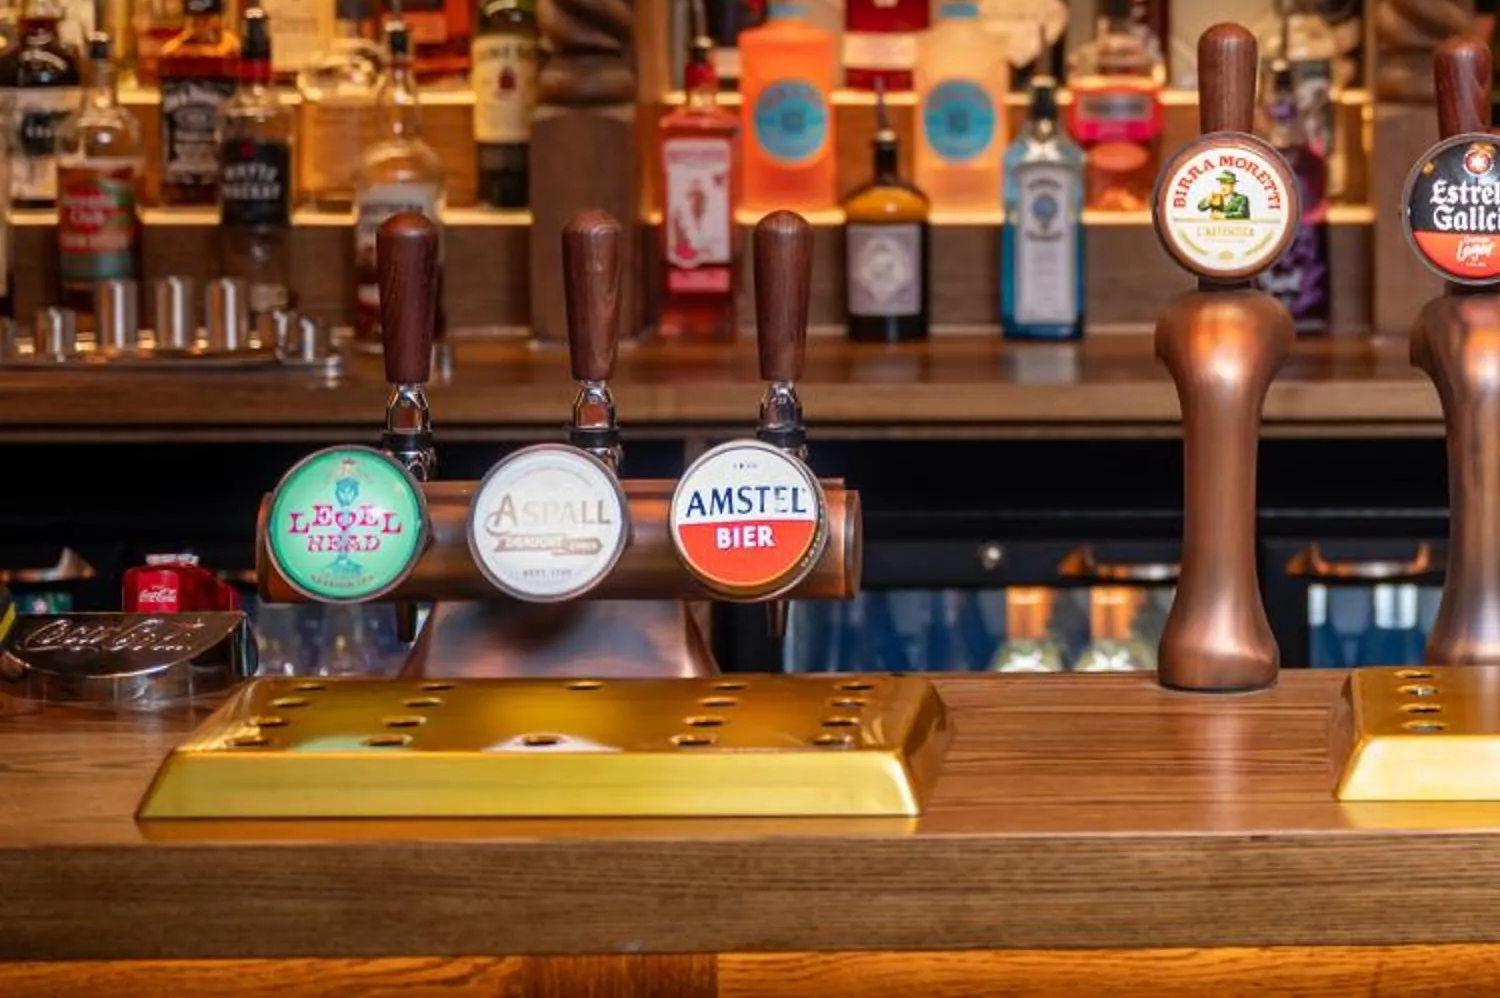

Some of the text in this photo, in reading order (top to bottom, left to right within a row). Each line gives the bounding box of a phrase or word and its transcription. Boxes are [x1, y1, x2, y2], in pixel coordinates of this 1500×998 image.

[1172, 154, 1282, 210] BIRRA MORETTI
[484, 492, 611, 534] ASPALL
[685, 486, 807, 518] AMSTEL
[307, 534, 381, 553] HEAD
[715, 525, 776, 550] BIER
